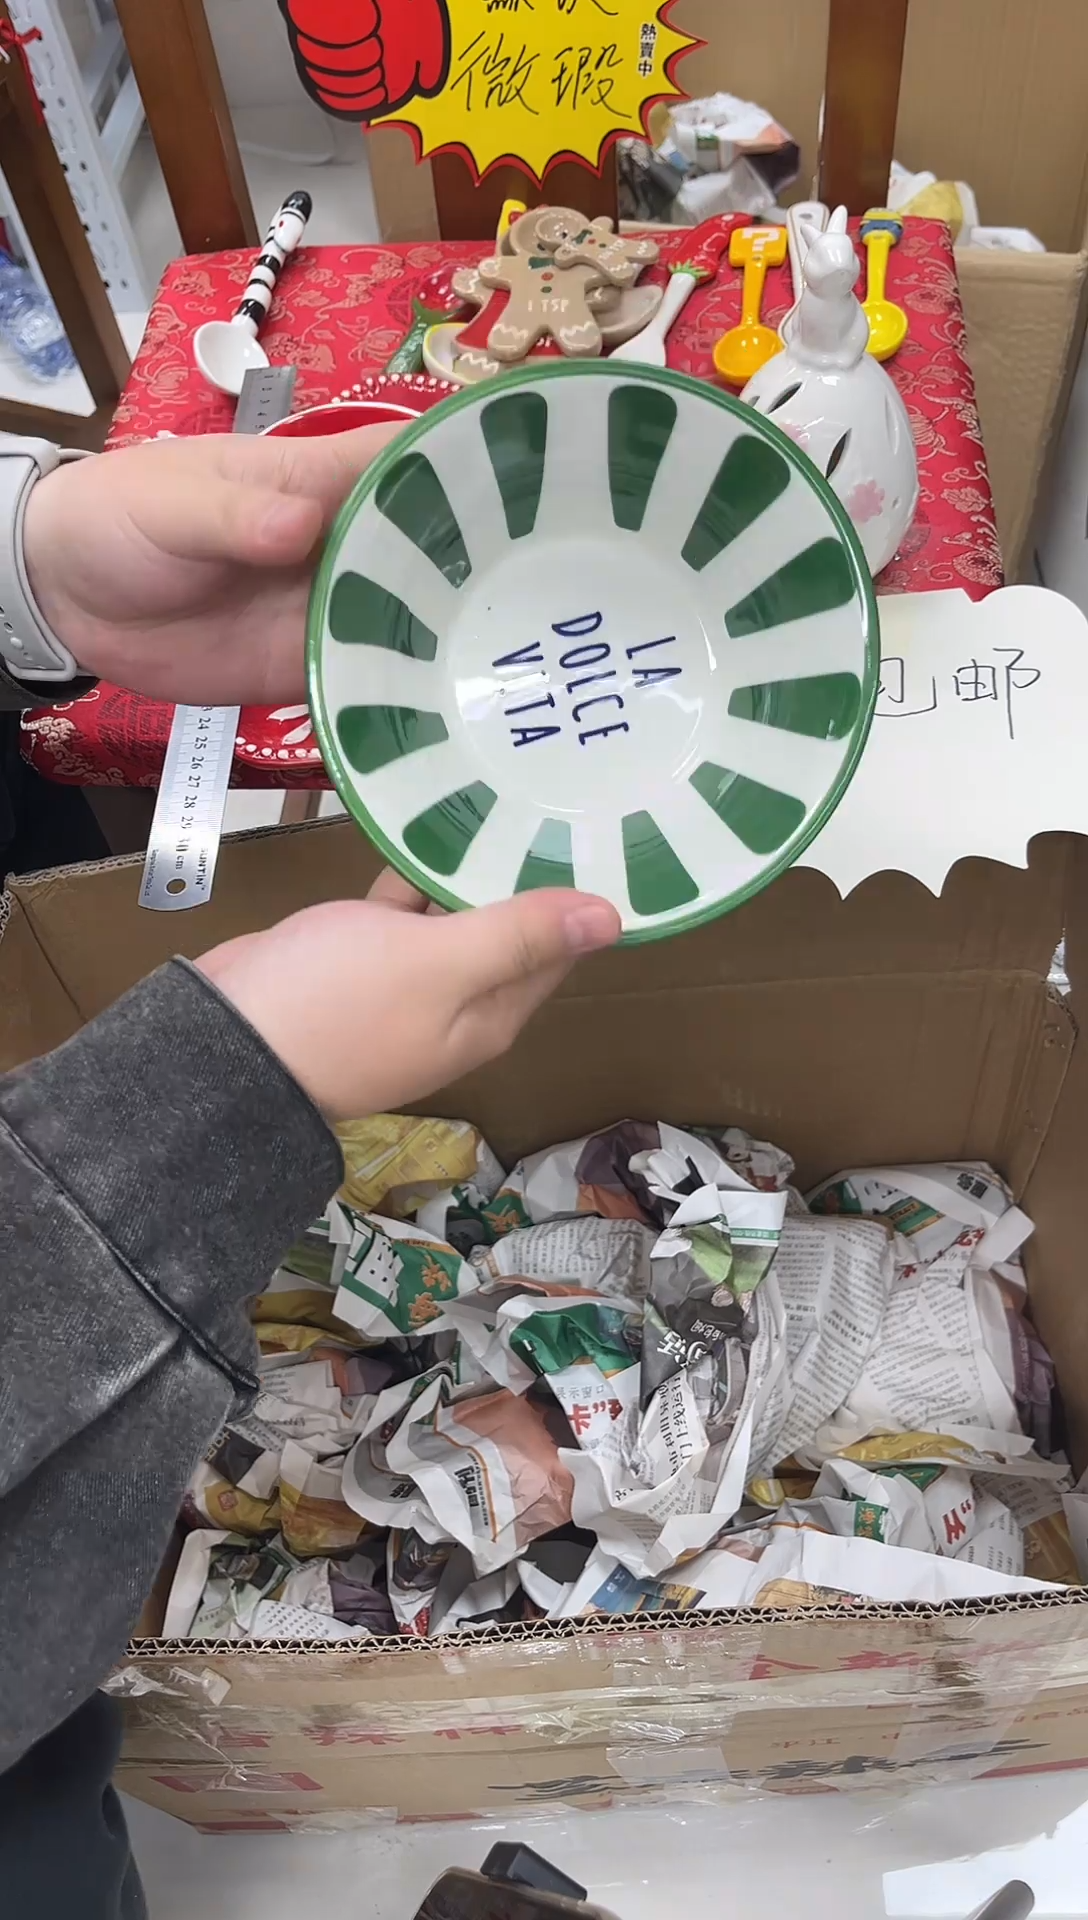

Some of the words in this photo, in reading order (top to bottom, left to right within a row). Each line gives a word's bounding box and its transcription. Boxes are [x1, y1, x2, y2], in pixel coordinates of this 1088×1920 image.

[540, 299, 570, 313] TSP
[626, 636, 682, 688] LA
[552, 612, 629, 746] DOLCE
[197, 717, 211, 730] 24
[194, 736, 208, 750] 25
[190, 756, 204, 770] 26
[187, 775, 201, 789] 27
[183, 795, 198, 809] 28
